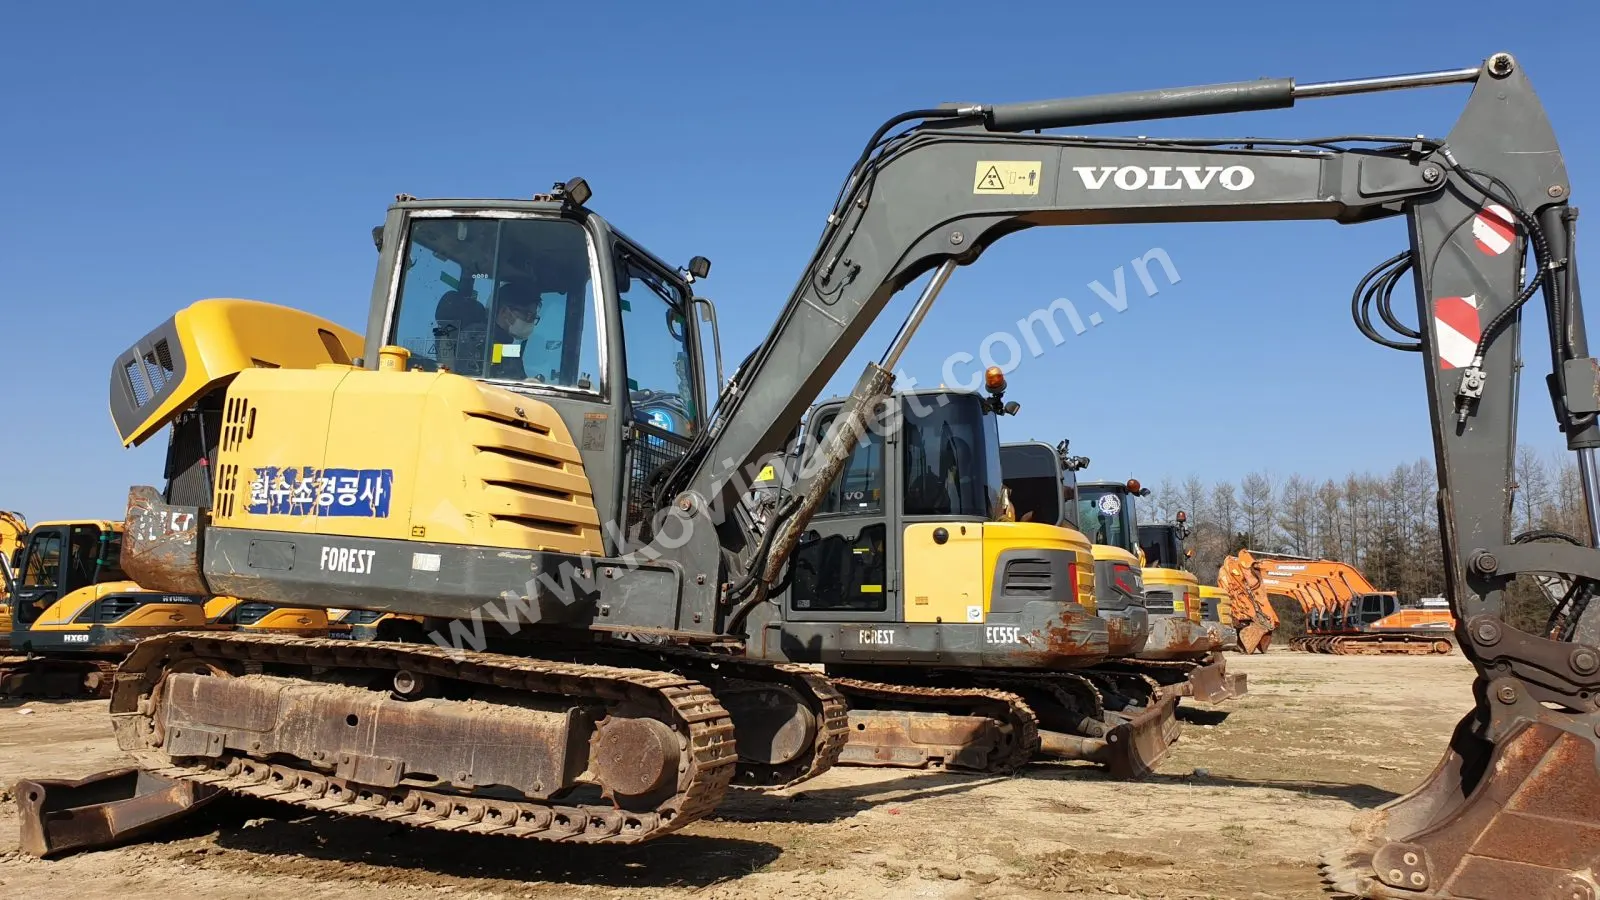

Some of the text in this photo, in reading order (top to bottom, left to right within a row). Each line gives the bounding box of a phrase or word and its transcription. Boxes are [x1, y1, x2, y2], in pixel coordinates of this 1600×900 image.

[1072, 165, 1256, 191] VOLVO
[320, 546, 376, 574] FOREST
[64, 634, 89, 643] HX60
[859, 629, 895, 644] FOREST
